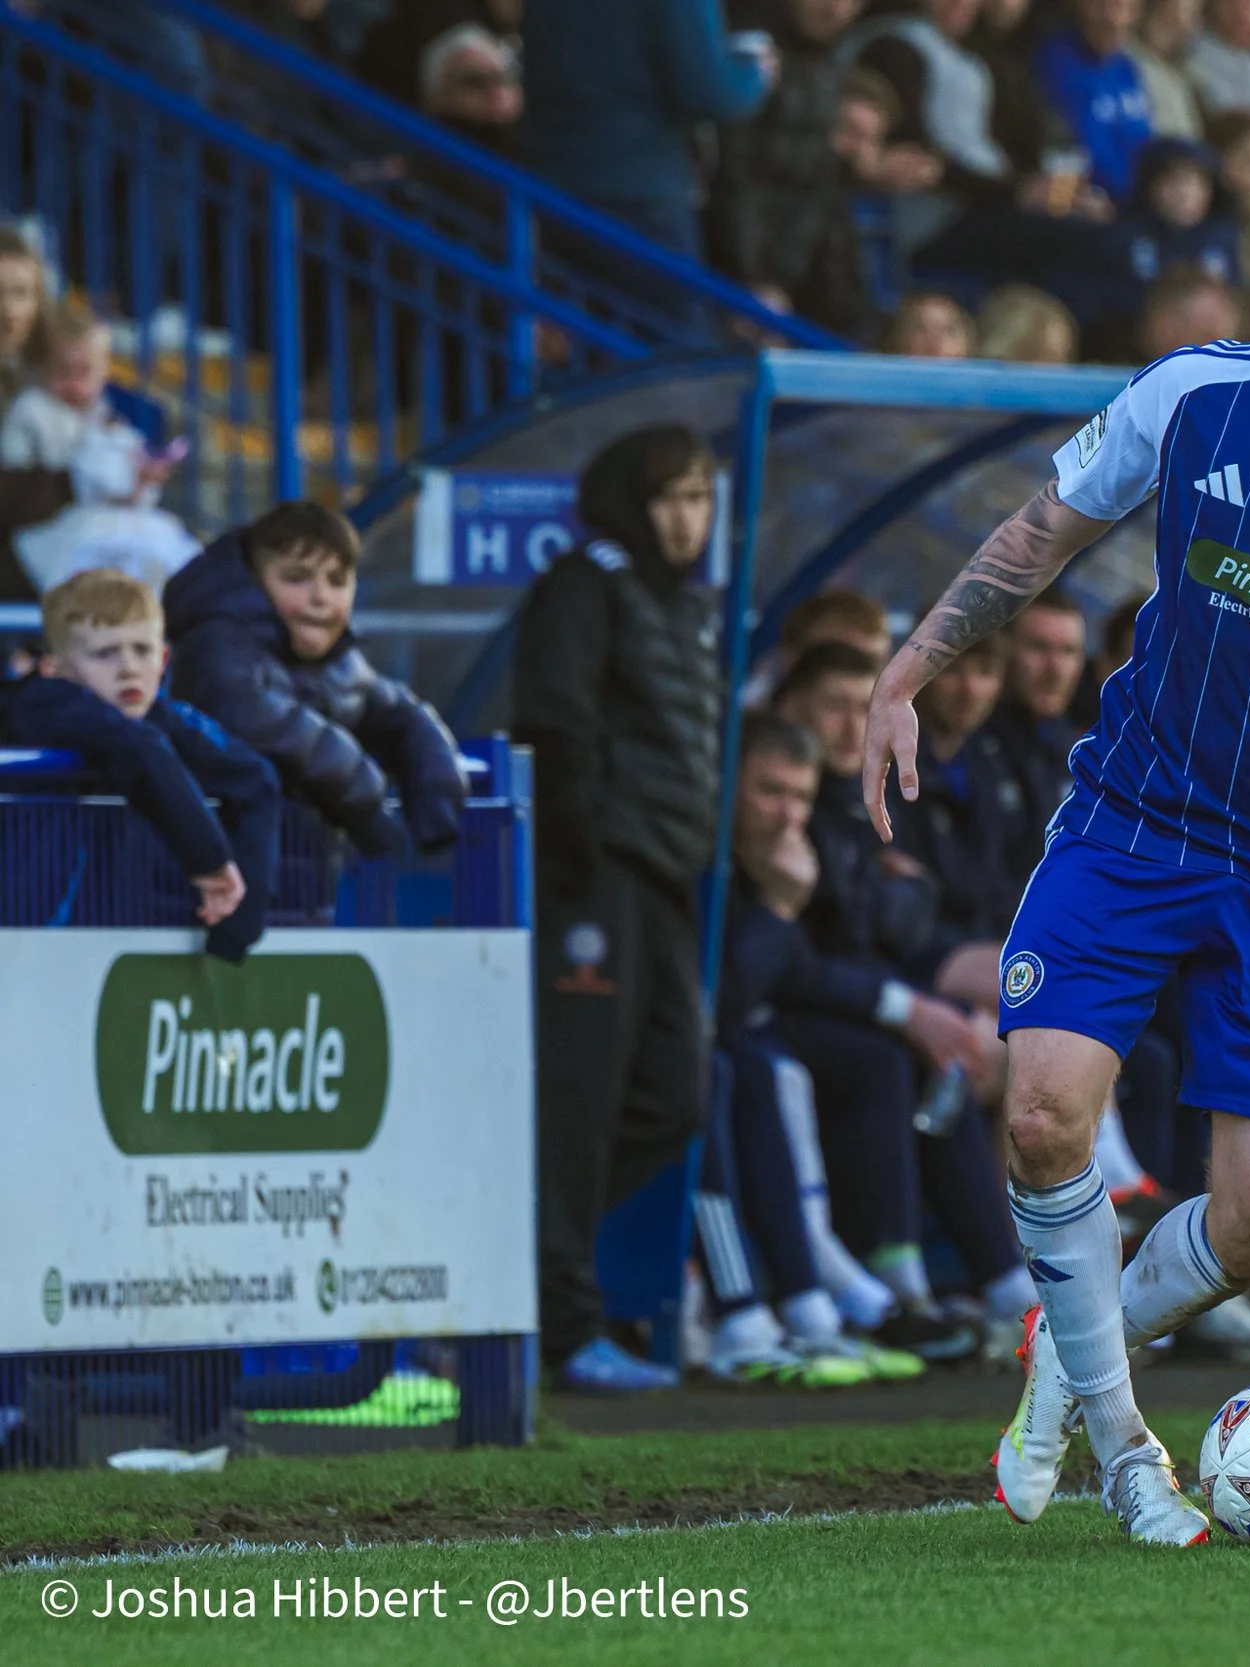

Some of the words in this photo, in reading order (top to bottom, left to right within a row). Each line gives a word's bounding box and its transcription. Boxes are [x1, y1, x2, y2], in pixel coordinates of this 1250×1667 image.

[143, 993, 345, 1112] Pinnacle
[146, 1172, 249, 1227] Electrical
[254, 1170, 346, 1239] Supplies
